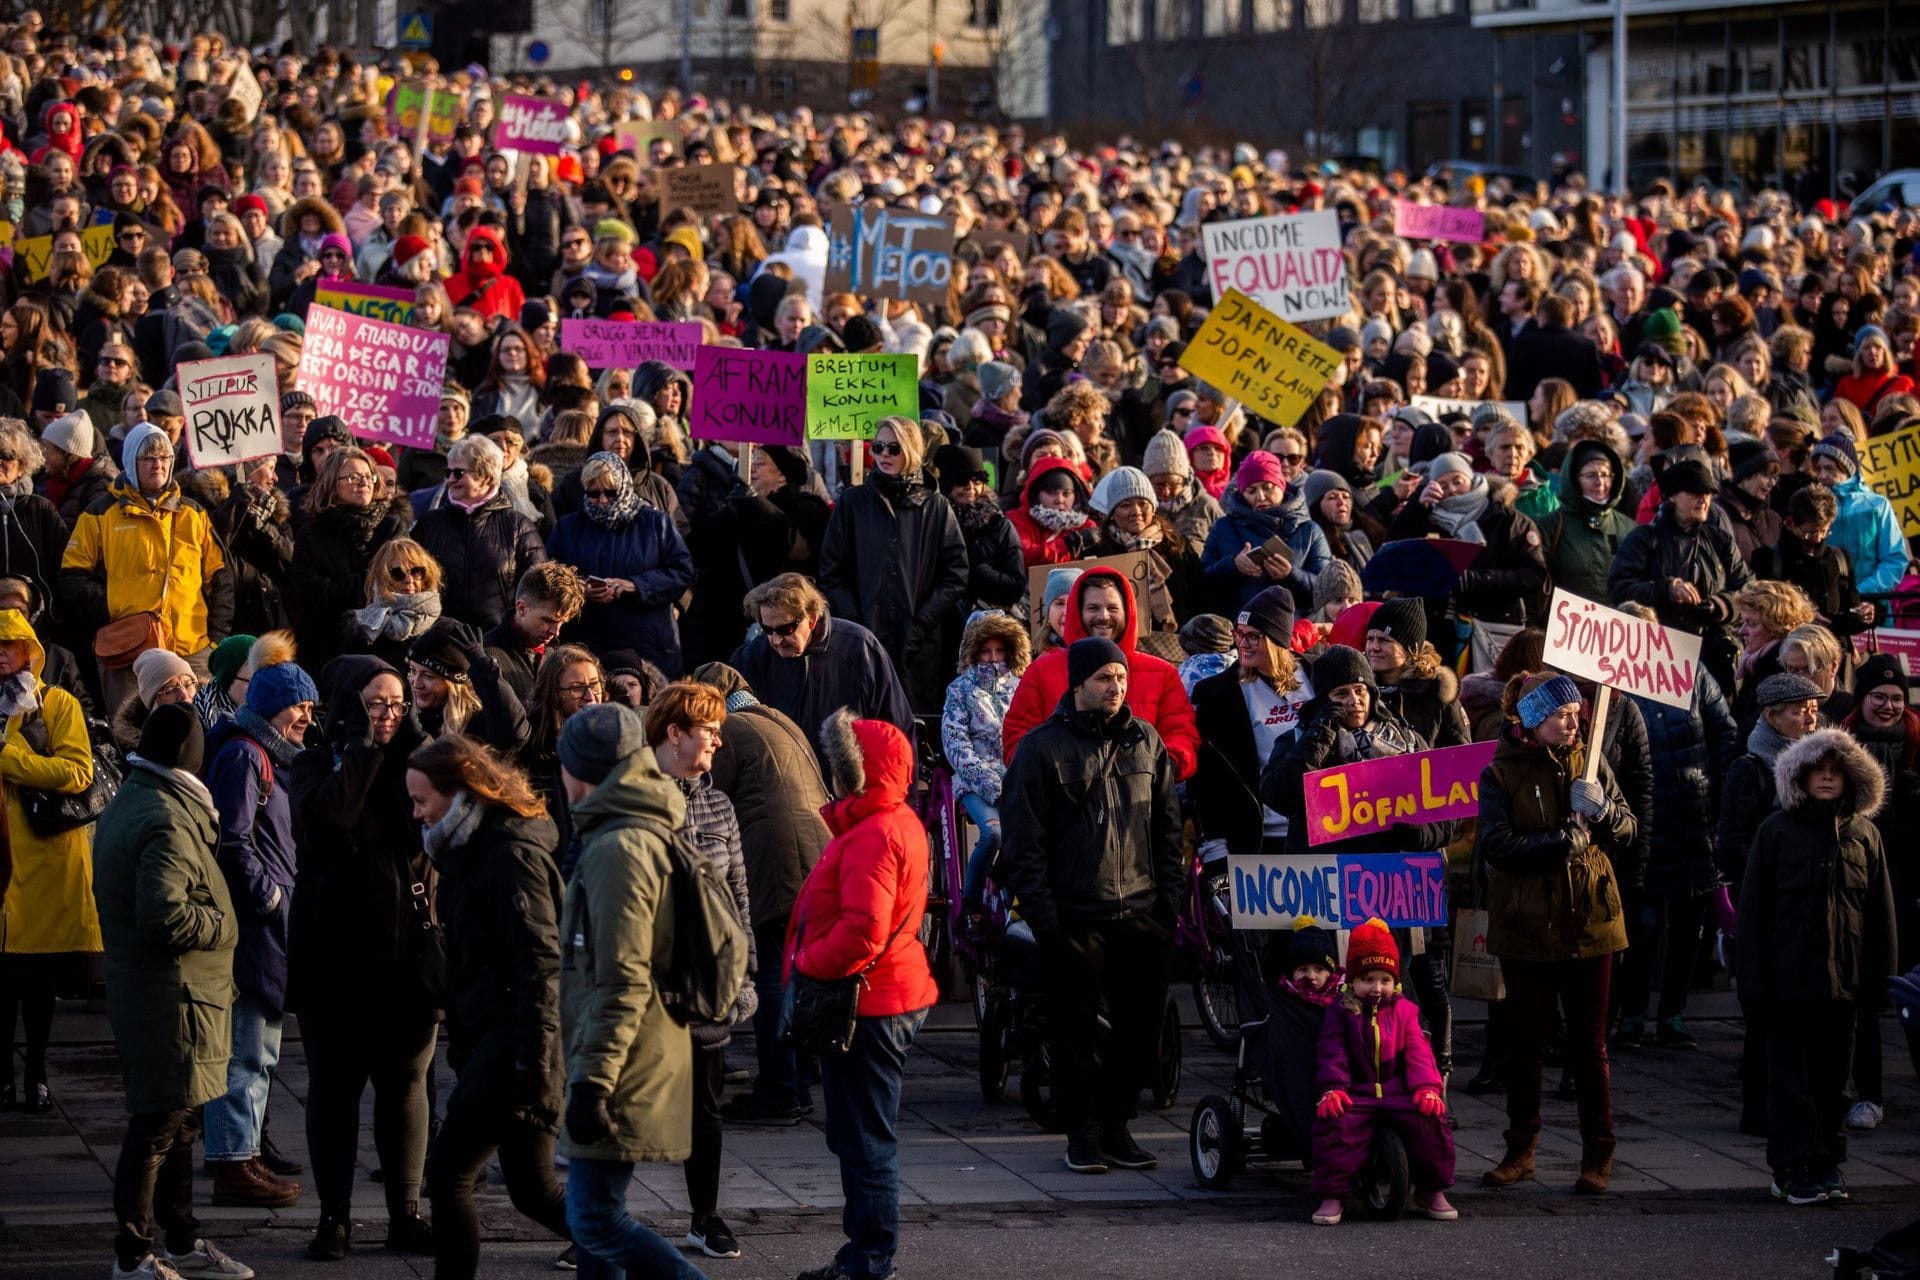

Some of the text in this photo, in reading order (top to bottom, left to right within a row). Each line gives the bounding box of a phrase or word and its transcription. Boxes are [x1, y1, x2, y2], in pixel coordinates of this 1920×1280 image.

[1212, 221, 1304, 254] INCOME
[1212, 247, 1344, 296] EQUALITY
[1284, 277, 1347, 315] NOW!
[305, 333, 344, 360] VERA
[1206, 328, 1273, 374] JÖFN
[1221, 299, 1338, 379] JAFNRÉTTI
[301, 353, 332, 377] ERT
[703, 352, 807, 397] ÁFRAM
[815, 360, 897, 377] BREYTUM
[835, 377, 886, 391] EKKI
[346, 388, 389, 413] 26%
[823, 394, 898, 408] KONUM
[1230, 369, 1283, 411] 14:55
[193, 403, 276, 454] ROKKA
[703, 399, 800, 439] KONUR
[1553, 600, 1674, 662] STÖNDUM
[1598, 656, 1694, 698] SAMAN
[1320, 773, 1417, 834] JÖFN
[1235, 864, 1340, 923] INCOME
[1361, 956, 1396, 968] ICEWEAR
